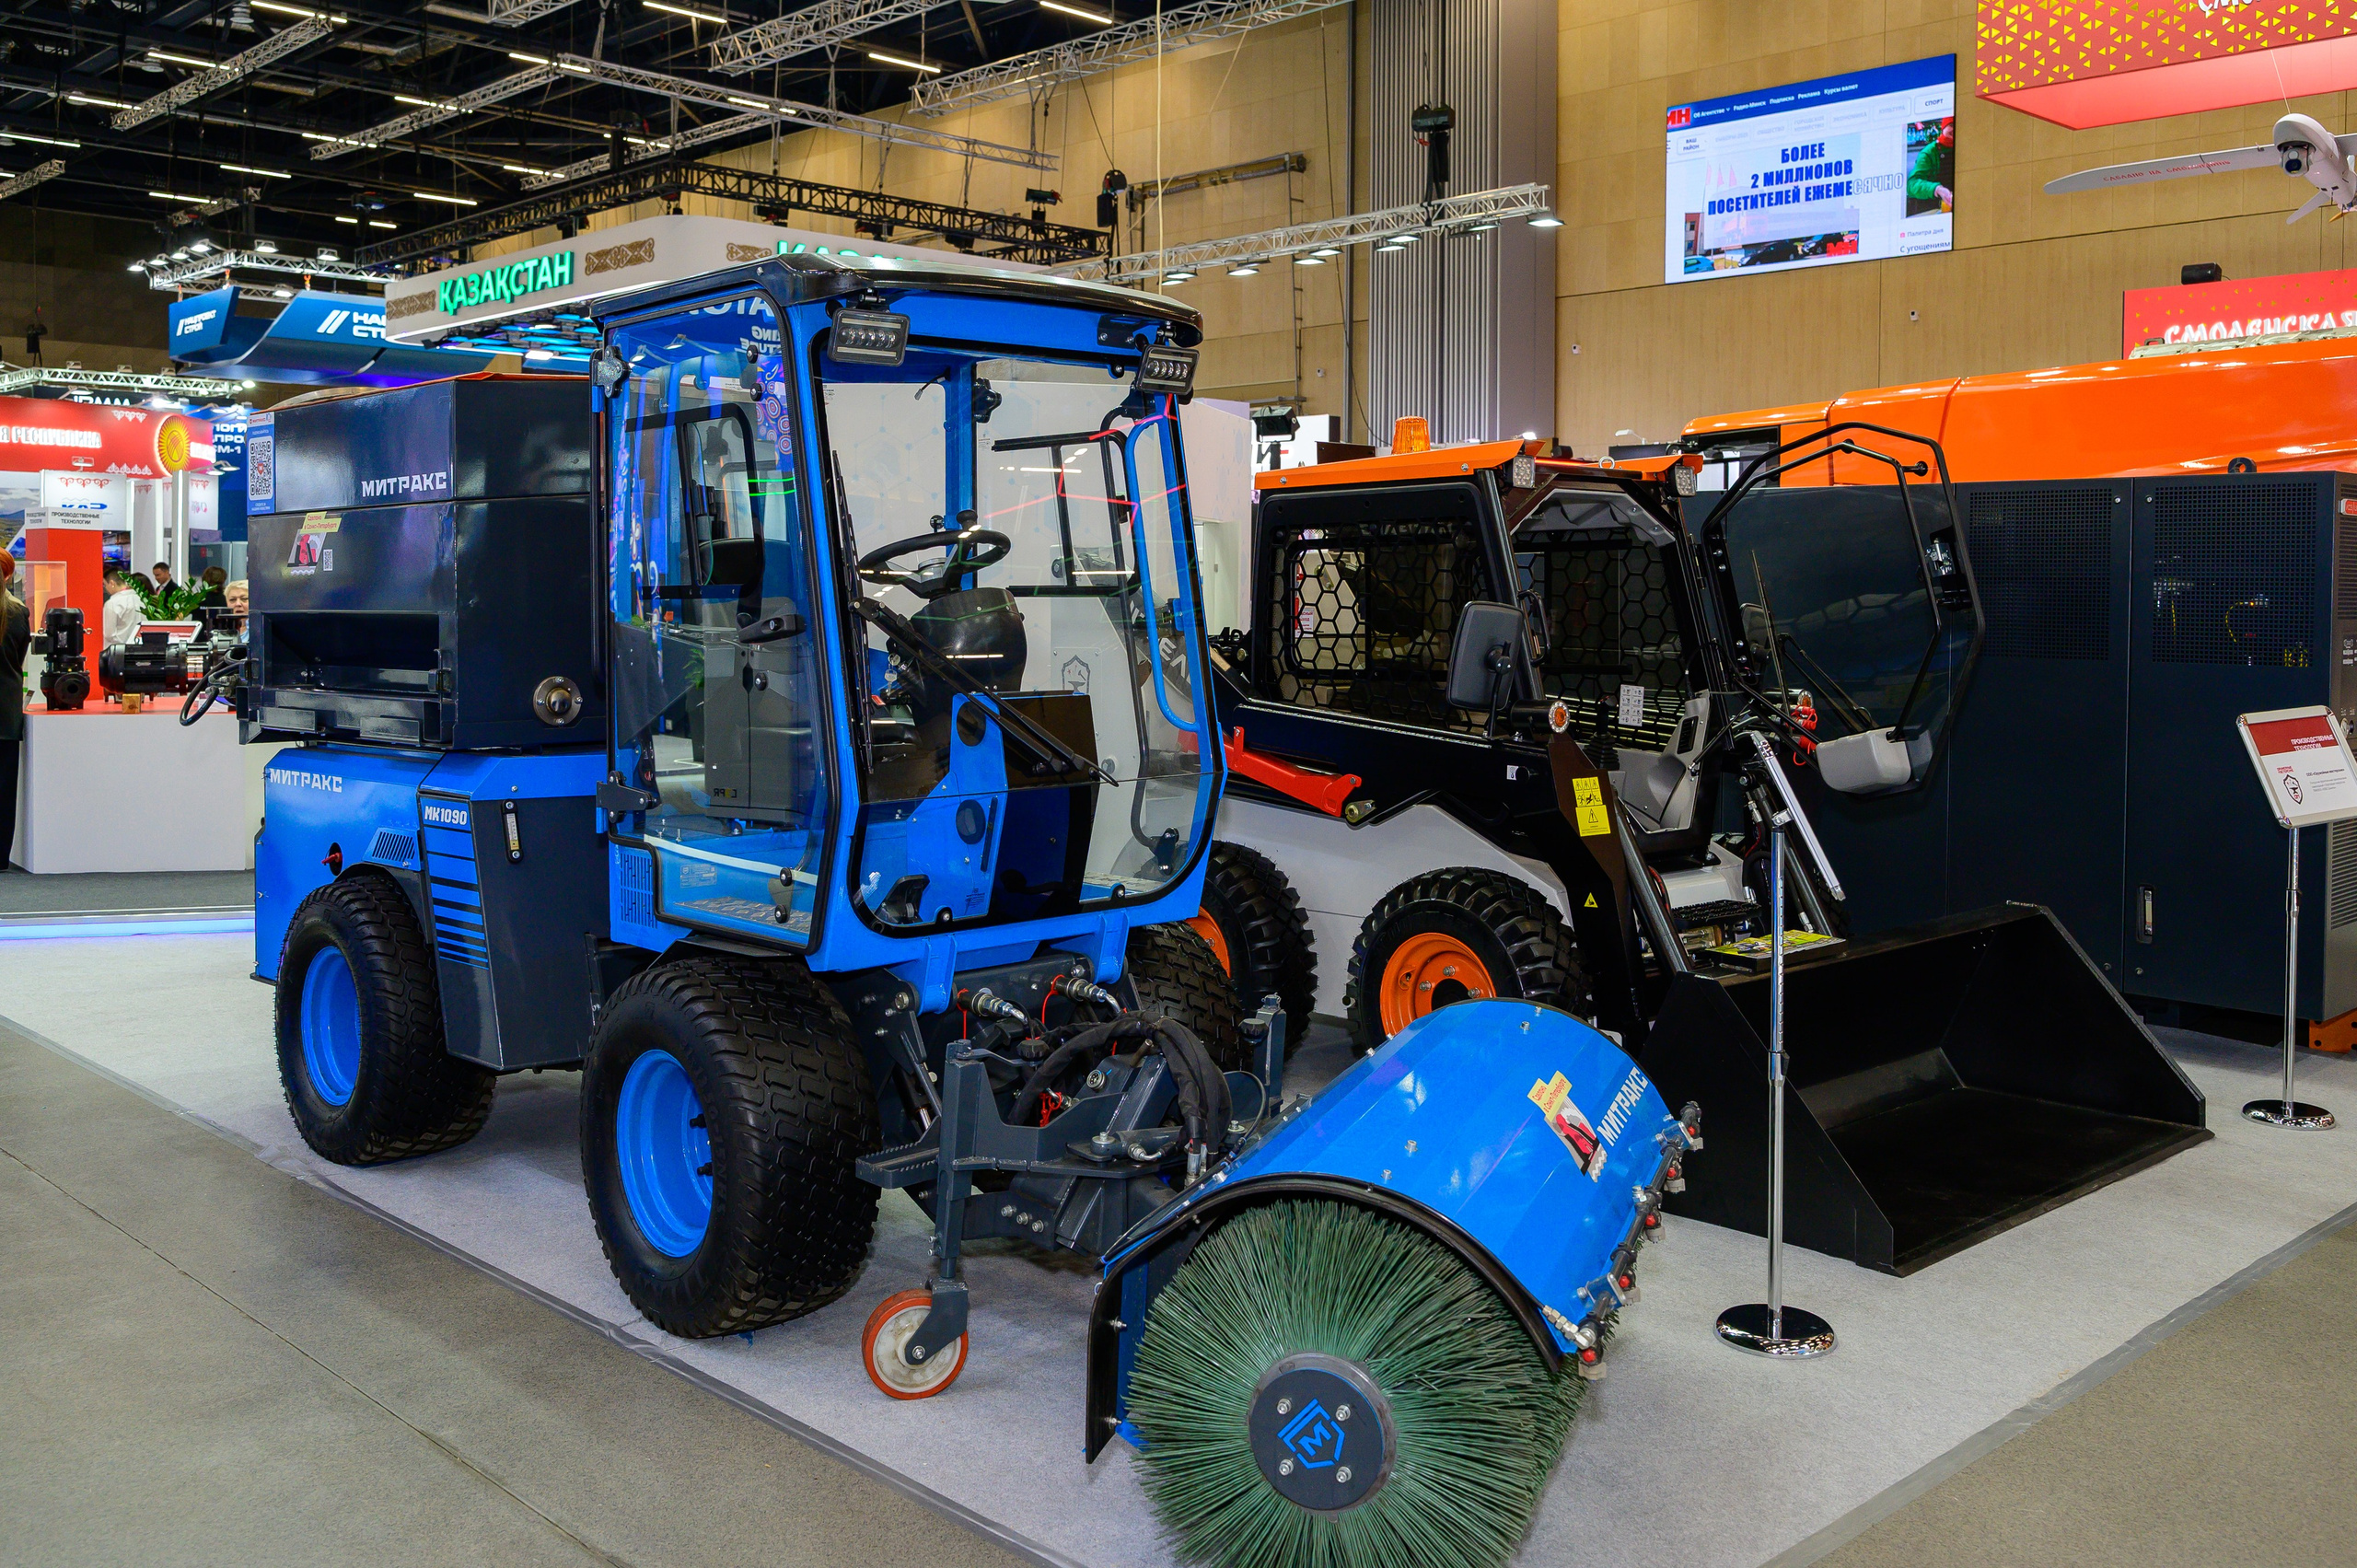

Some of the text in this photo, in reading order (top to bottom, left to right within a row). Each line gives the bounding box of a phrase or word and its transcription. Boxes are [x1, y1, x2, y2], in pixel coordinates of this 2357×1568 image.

[1925, 99, 1944, 107] СПОРТ
[1781, 142, 1826, 164] БОЛЕЕ
[1751, 159, 1853, 189] 2 МИЛЛИОНОВ
[1708, 172, 1904, 215] ПОСЕТИТЕЛЕЙ ЕЖЕМЕСЯЧНО
[439, 250, 575, 316] ҚАЗАҚСТАН
[12, 425, 102, 449] РЕСПУБЛИКА
[361, 471, 447, 497] МИТРАКС
[269, 768, 342, 793] МИТРАКС
[424, 805, 468, 825] МК1090
[1596, 1066, 1649, 1147] МИТРАКС
